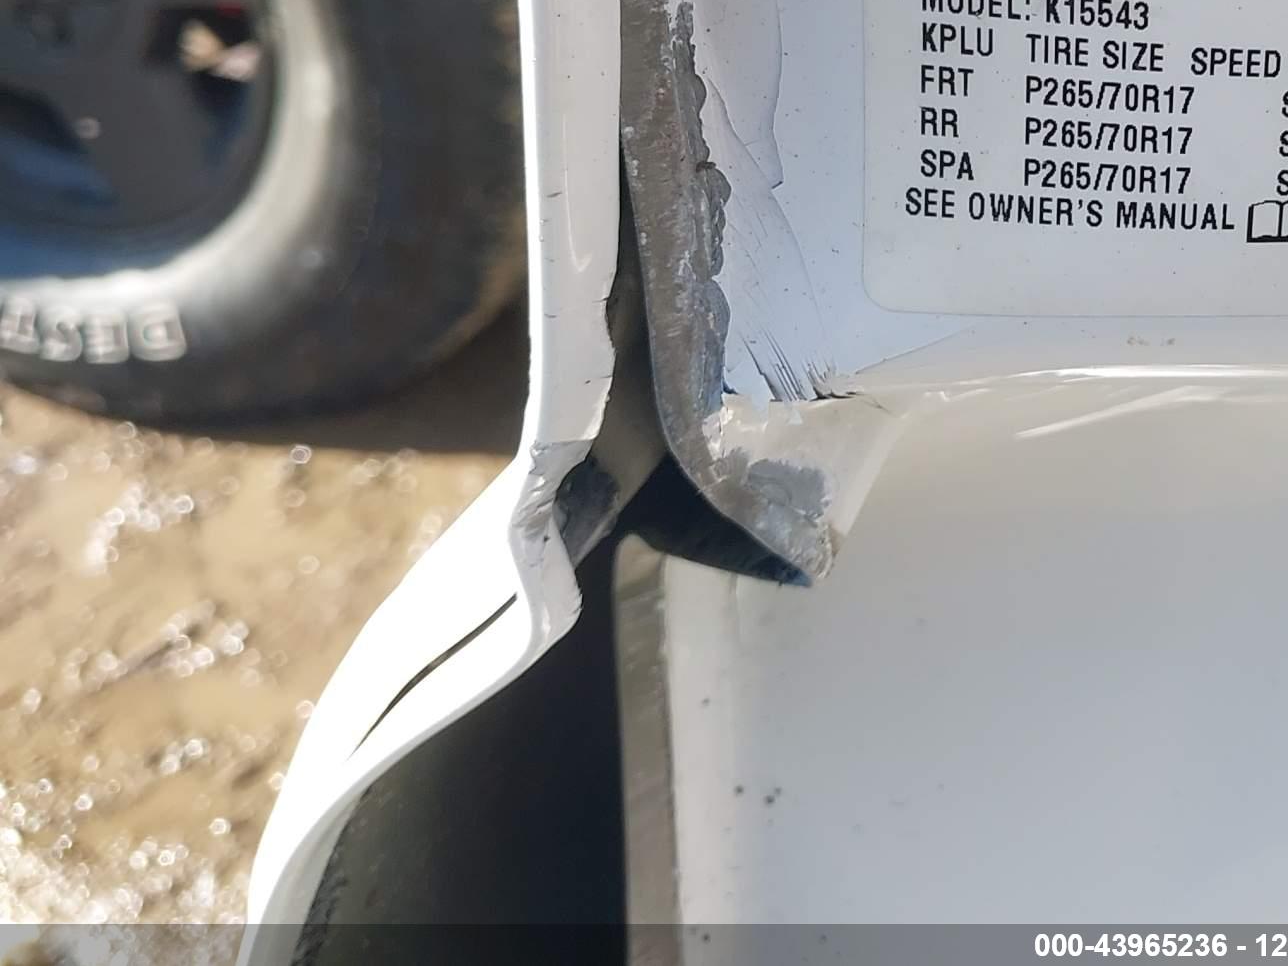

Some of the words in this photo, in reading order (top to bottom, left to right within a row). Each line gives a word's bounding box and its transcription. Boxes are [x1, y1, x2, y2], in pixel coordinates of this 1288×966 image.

[922, 22, 993, 57] KPLU
[1025, 34, 1089, 67] TIRE
[1103, 40, 1164, 72] SIZE
[1191, 47, 1281, 78] SPEED
[921, 64, 974, 97] FRT
[1026, 75, 1194, 114] P265/70R17
[920, 106, 959, 138] RR
[1025, 117, 1192, 154] P265/70R17
[921, 149, 974, 180] SPA
[1024, 158, 1191, 194] P265/70R17
[906, 187, 955, 218] SEE
[969, 192, 1103, 227] OWNER'S
[1116, 201, 1235, 230] MANUAL
